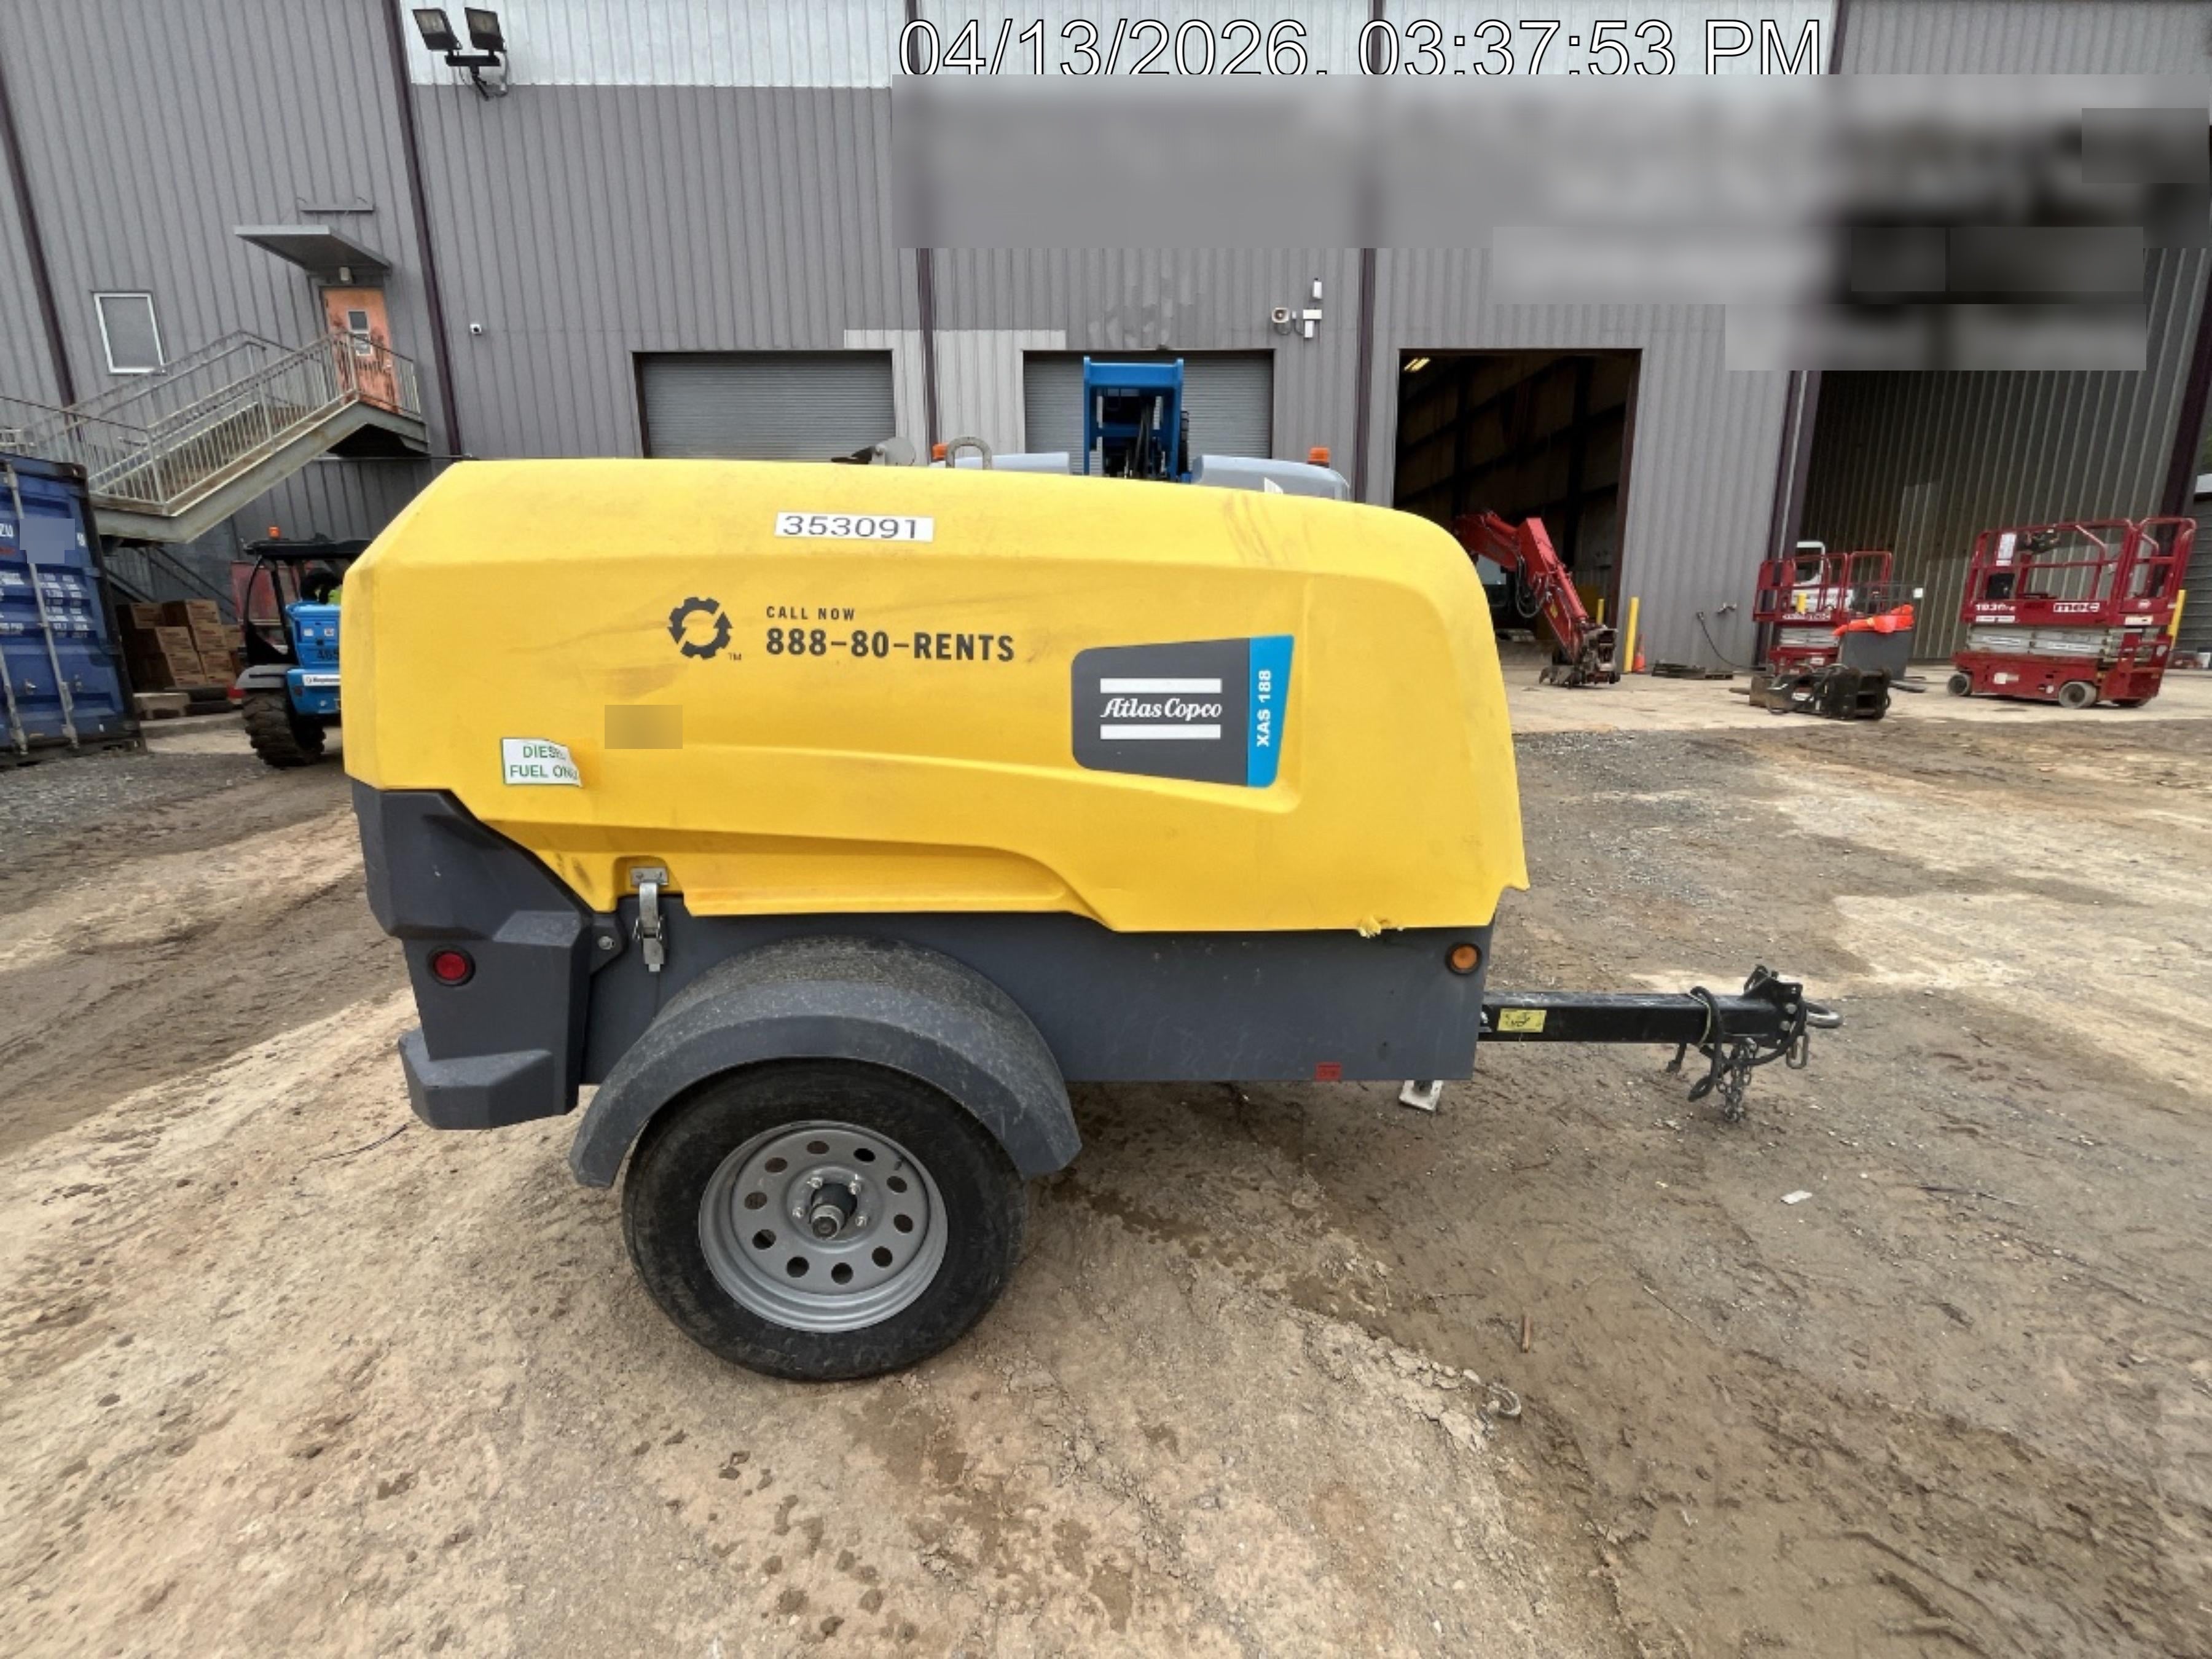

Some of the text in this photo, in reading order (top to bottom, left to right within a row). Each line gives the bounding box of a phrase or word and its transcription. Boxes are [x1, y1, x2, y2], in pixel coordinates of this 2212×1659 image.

[783, 515, 916, 539] 353091
[766, 606, 855, 621] CALL NOW
[766, 627, 1014, 662] 888-80-RENTS
[1100, 697, 1223, 721] Atlas Copco
[1257, 670, 1271, 747] XAS 188
[510, 764, 548, 777] FUEL
